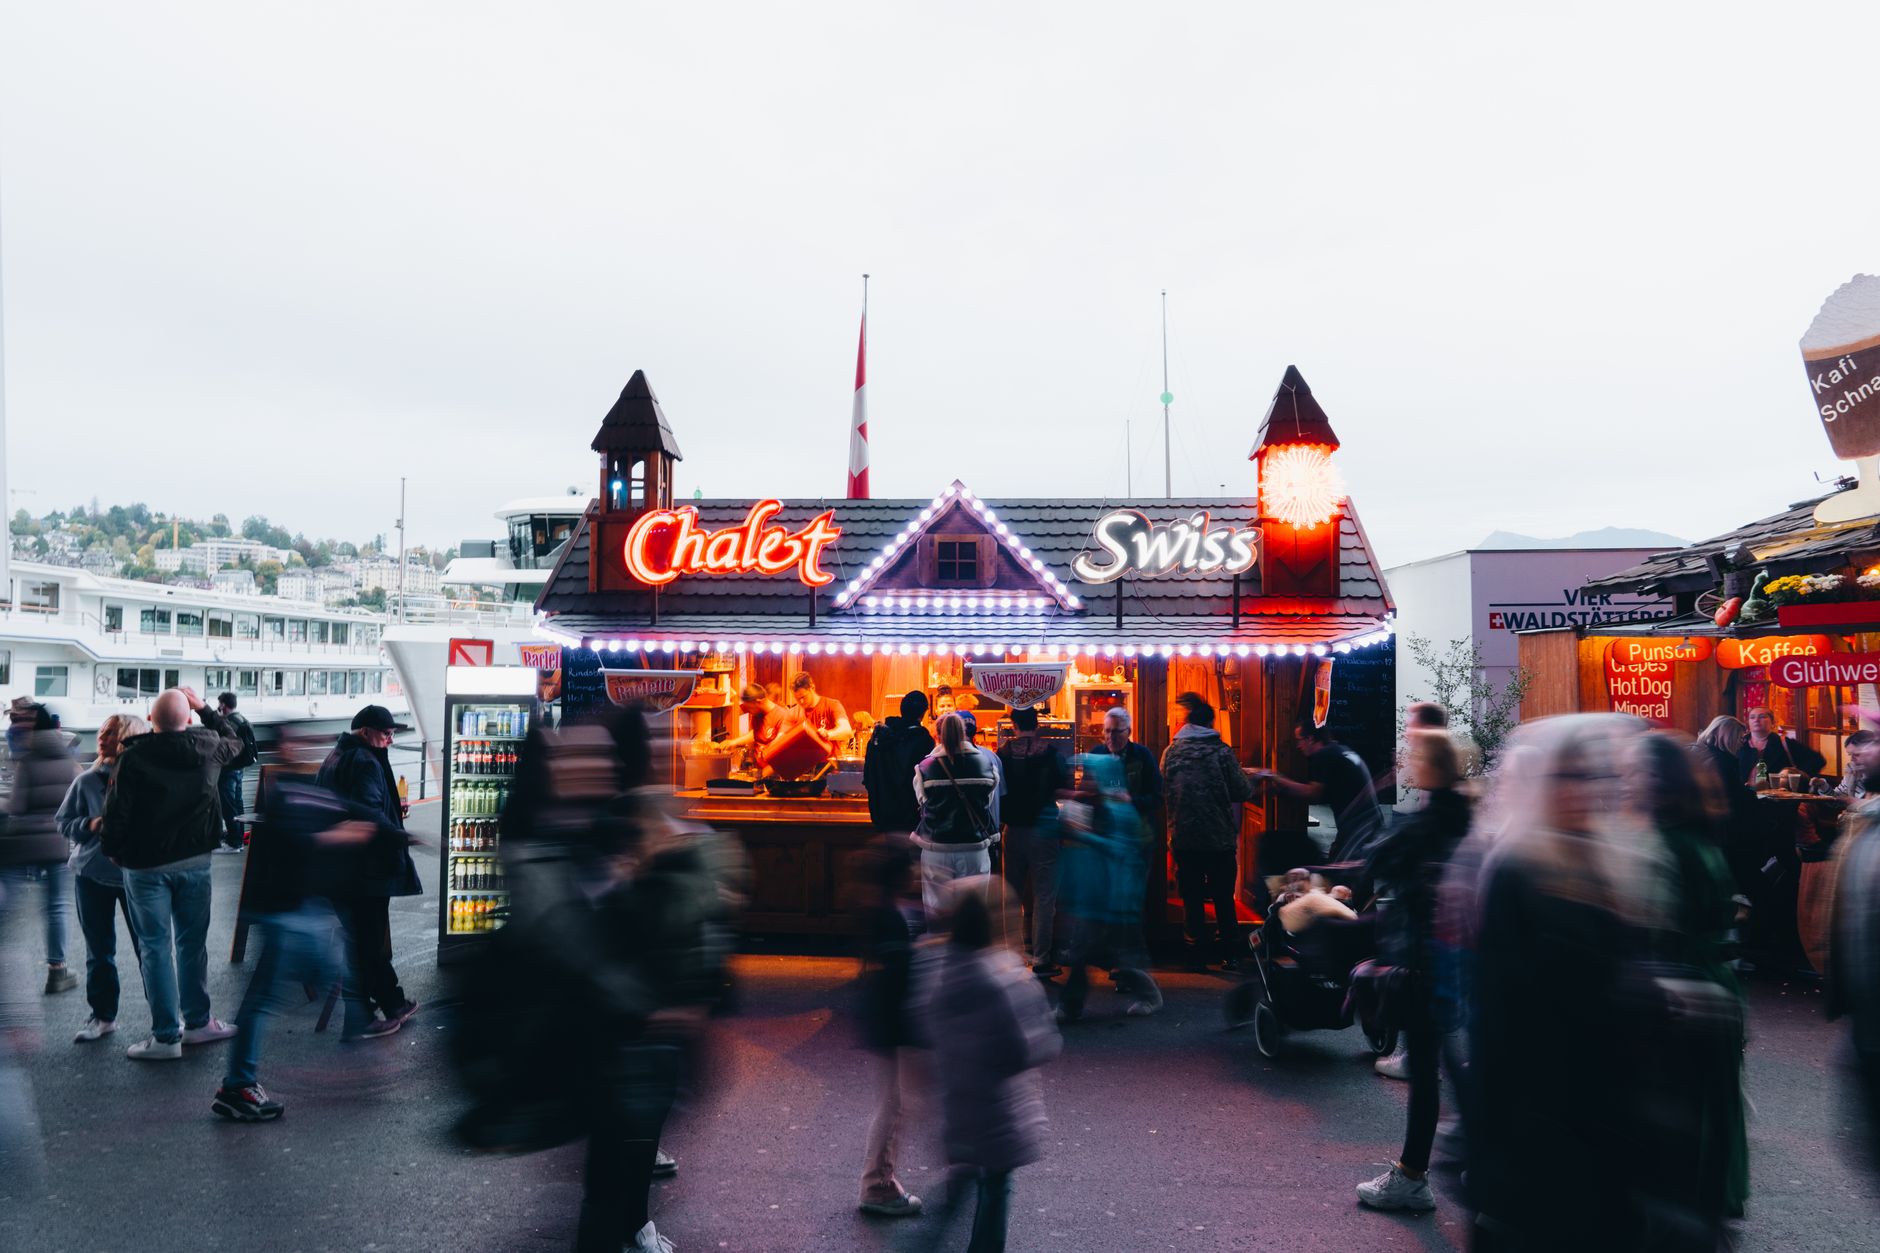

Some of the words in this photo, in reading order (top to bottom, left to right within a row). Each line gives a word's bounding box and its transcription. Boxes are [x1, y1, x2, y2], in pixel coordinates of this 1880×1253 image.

[1811, 354, 1857, 394] Kafi
[625, 500, 842, 586] Chalet
[1072, 510, 1262, 583] Swiss
[1563, 589, 1613, 606] VIER
[1629, 643, 1697, 661] Punsch
[1739, 642, 1817, 664] Kaffee
[980, 671, 1057, 693] Älplermagronen
[1783, 660, 1880, 684] Glühwe
[614, 677, 676, 702] Raclette
[1610, 678, 1638, 696] Hot
[1640, 677, 1672, 699] Dog
[1614, 700, 1669, 718] Mineral
